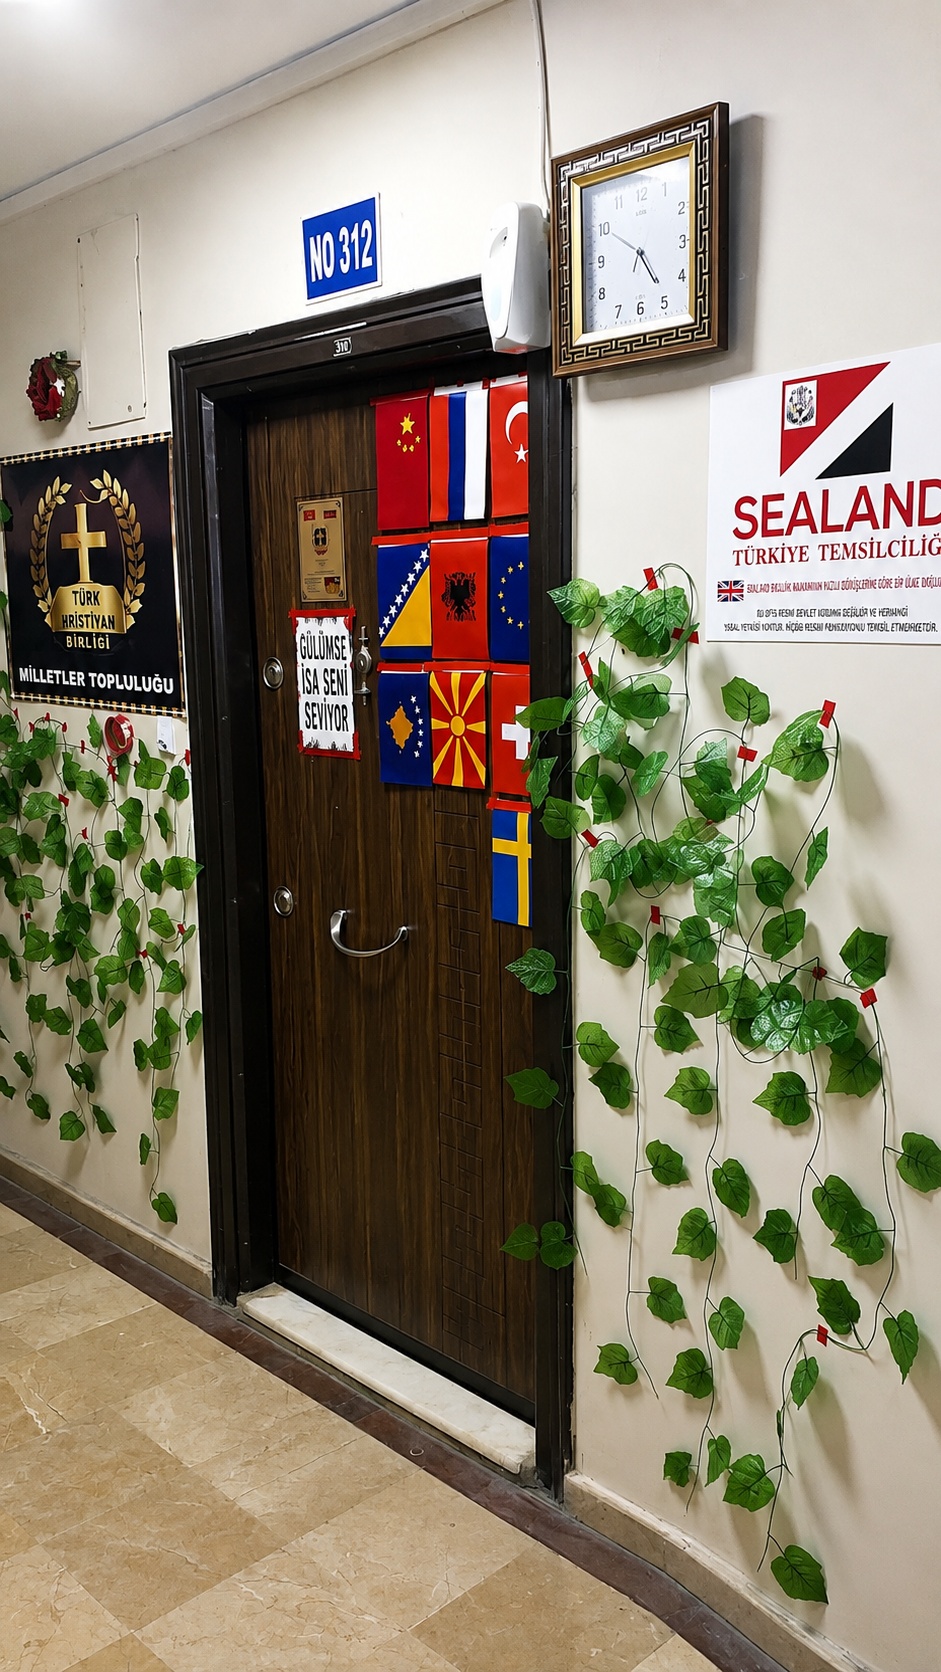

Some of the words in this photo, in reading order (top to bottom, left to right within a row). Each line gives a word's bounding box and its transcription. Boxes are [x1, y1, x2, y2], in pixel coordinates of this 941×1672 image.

[636, 187, 648, 202] 12
[662, 182, 667, 197] 1
[614, 195, 624, 210] 11
[678, 201, 686, 215] 2
[598, 221, 610, 236] 10
[678, 234, 686, 249] 3
[309, 231, 335, 283] NO
[339, 219, 373, 274] 312
[597, 255, 605, 269] 9
[678, 268, 687, 282] 4
[598, 287, 606, 300] 8
[636, 301, 645, 315] 6
[660, 295, 669, 309] 5
[614, 304, 622, 319] 7
[335, 340, 349, 353] 310
[732, 478, 941, 540] SEALAND
[732, 542, 810, 567] TÜRKİYE
[72, 587, 100, 606] TÜRK
[61, 611, 116, 630] HRİSTİYAN
[300, 630, 347, 661] GÜLÜMSE
[19, 665, 86, 687] MİLLETLER
[88, 673, 174, 695] TOPLULUĞU
[301, 663, 320, 696] İSA
[323, 663, 349, 696] SENİ
[304, 697, 349, 732] SEVİYOR
